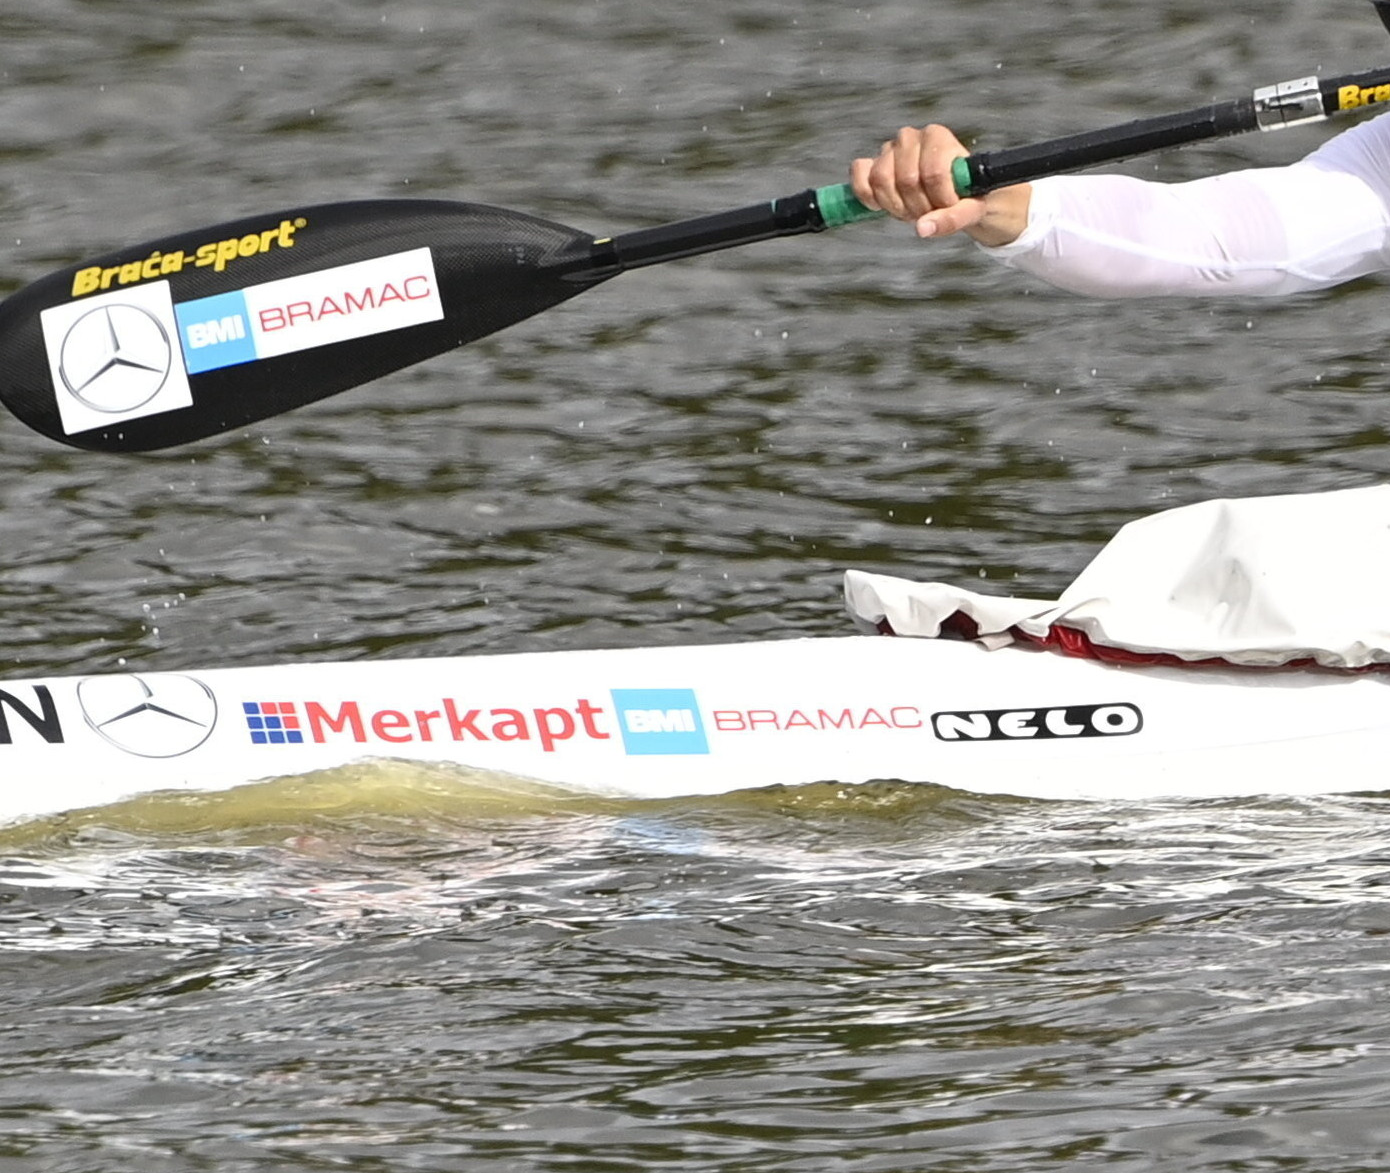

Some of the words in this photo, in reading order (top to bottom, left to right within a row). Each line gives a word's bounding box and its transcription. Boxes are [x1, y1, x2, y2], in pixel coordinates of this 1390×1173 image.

[187, 313, 245, 350] BMI
[259, 275, 431, 332] BRAMAC
[304, 697, 611, 752] Merkapt
[624, 709, 696, 733] BMI
[713, 706, 923, 731] BRAMAC
[936, 705, 1139, 739] NELO
